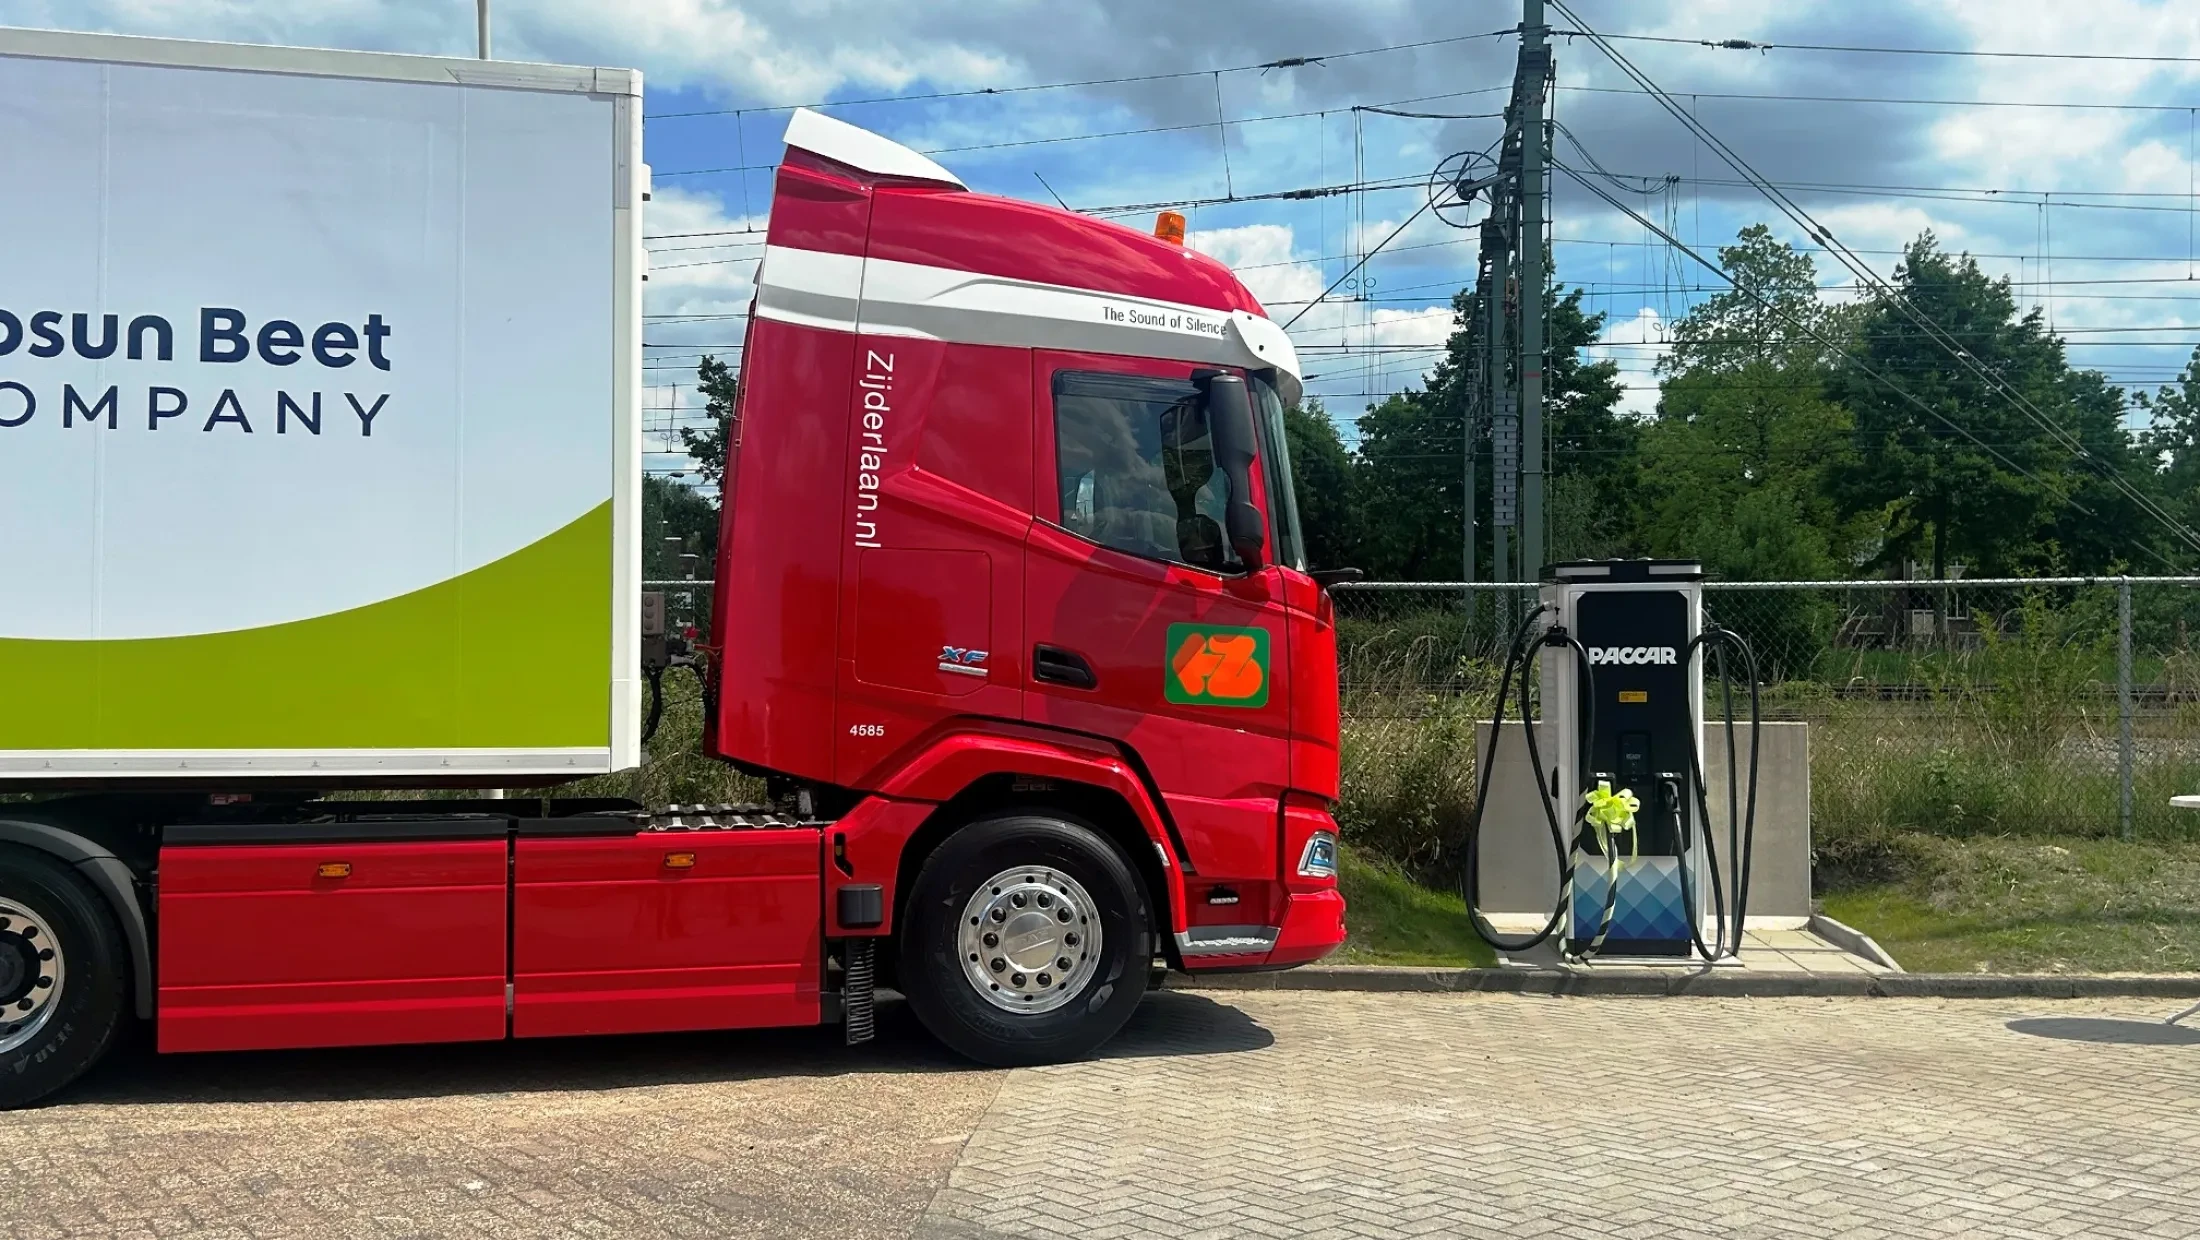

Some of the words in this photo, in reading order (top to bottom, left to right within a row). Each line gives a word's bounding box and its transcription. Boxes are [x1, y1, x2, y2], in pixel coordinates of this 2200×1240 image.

[1103, 306, 1124, 322] The
[1129, 309, 1166, 327] Sound
[1170, 314, 1181, 329] of
[1186, 317, 1228, 336] Silence
[200, 307, 391, 371] Beet
[0, 381, 391, 437] OMPANY
[855, 350, 894, 548] Zijderlaan.nl
[937, 645, 989, 664] XF
[1588, 646, 1678, 665] PACCAR
[849, 724, 885, 737] 4585
